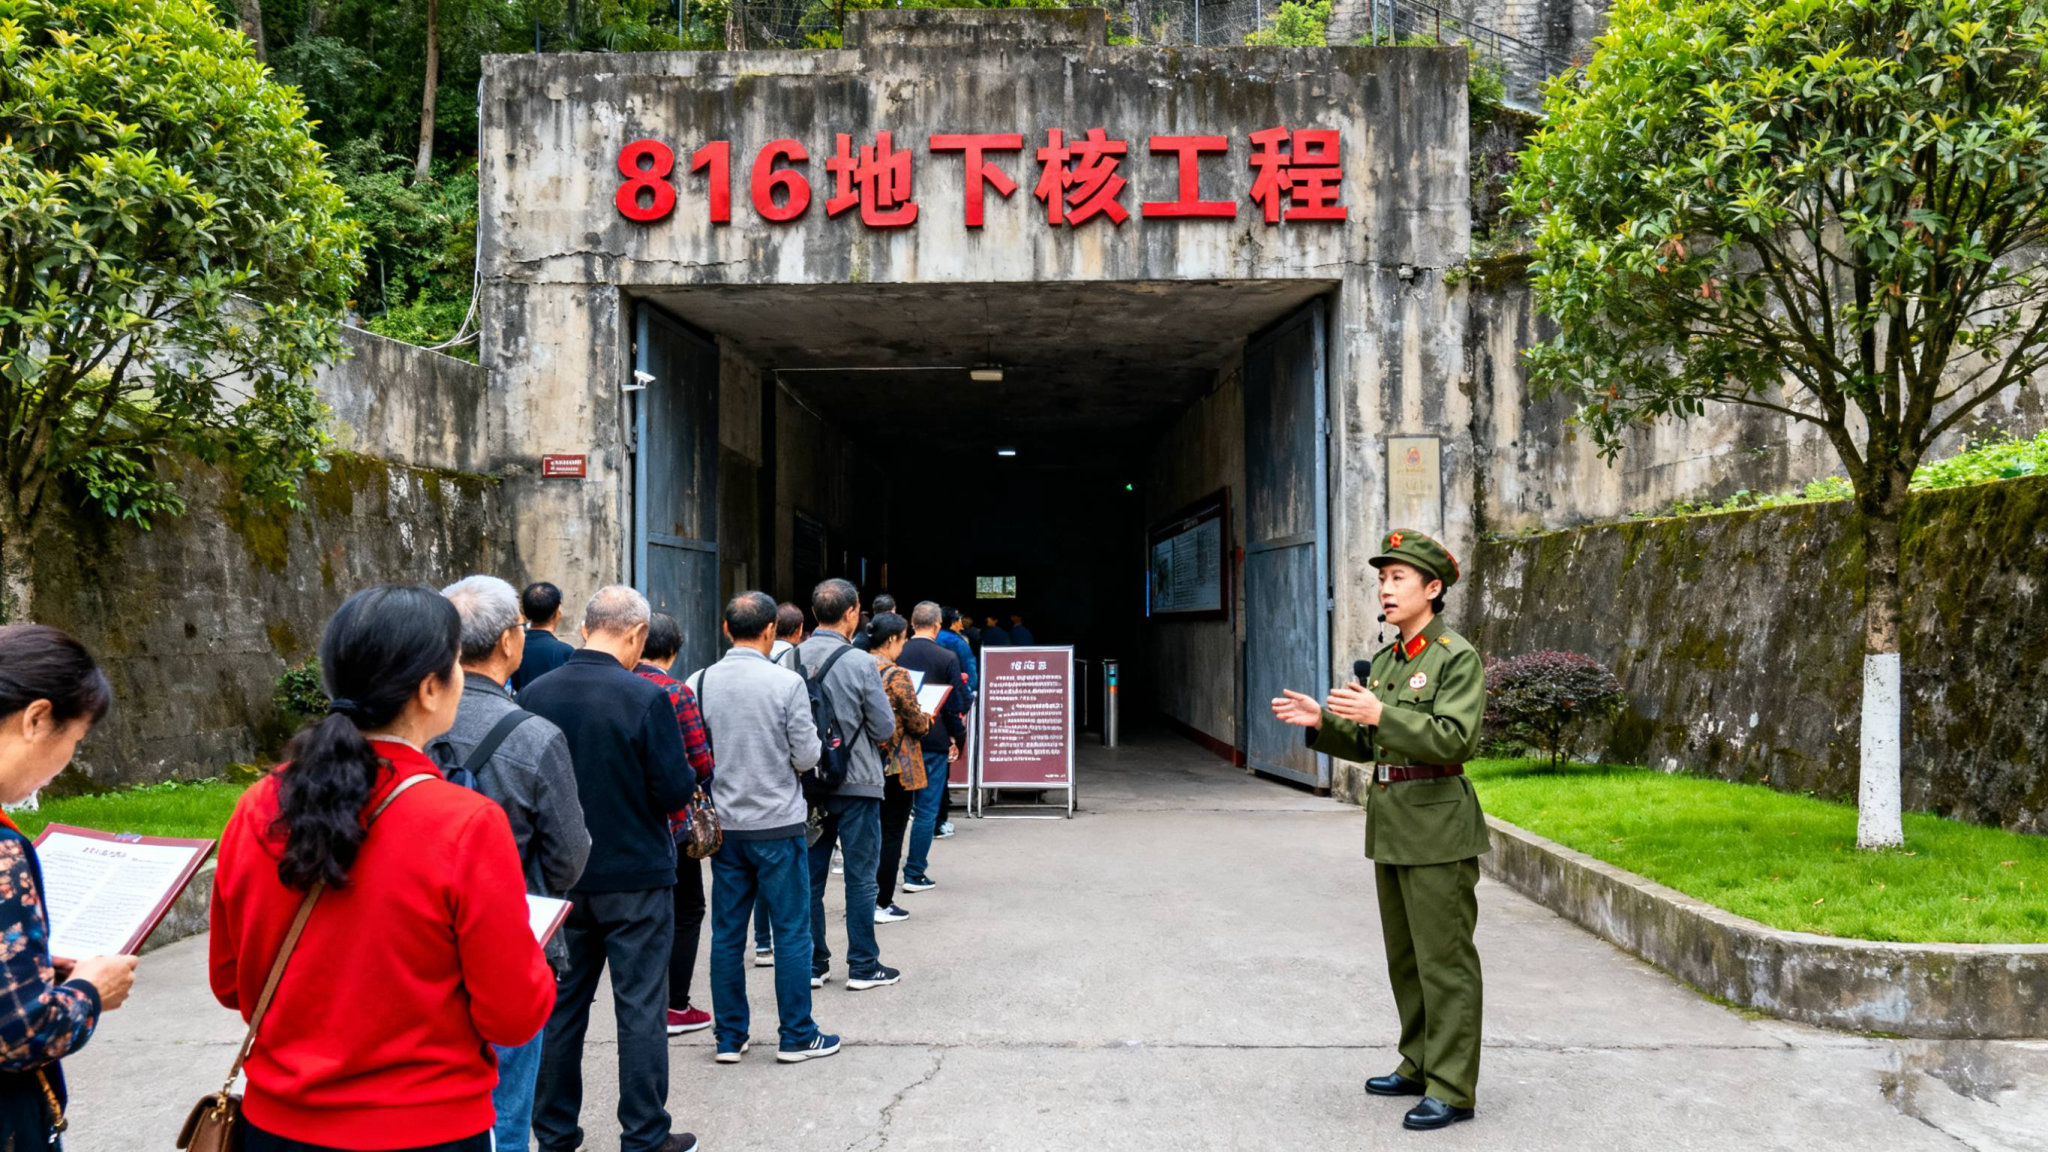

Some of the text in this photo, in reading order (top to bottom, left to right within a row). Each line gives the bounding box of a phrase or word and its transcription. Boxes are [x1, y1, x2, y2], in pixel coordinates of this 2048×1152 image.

[615, 125, 1347, 228] 816地下核工程
